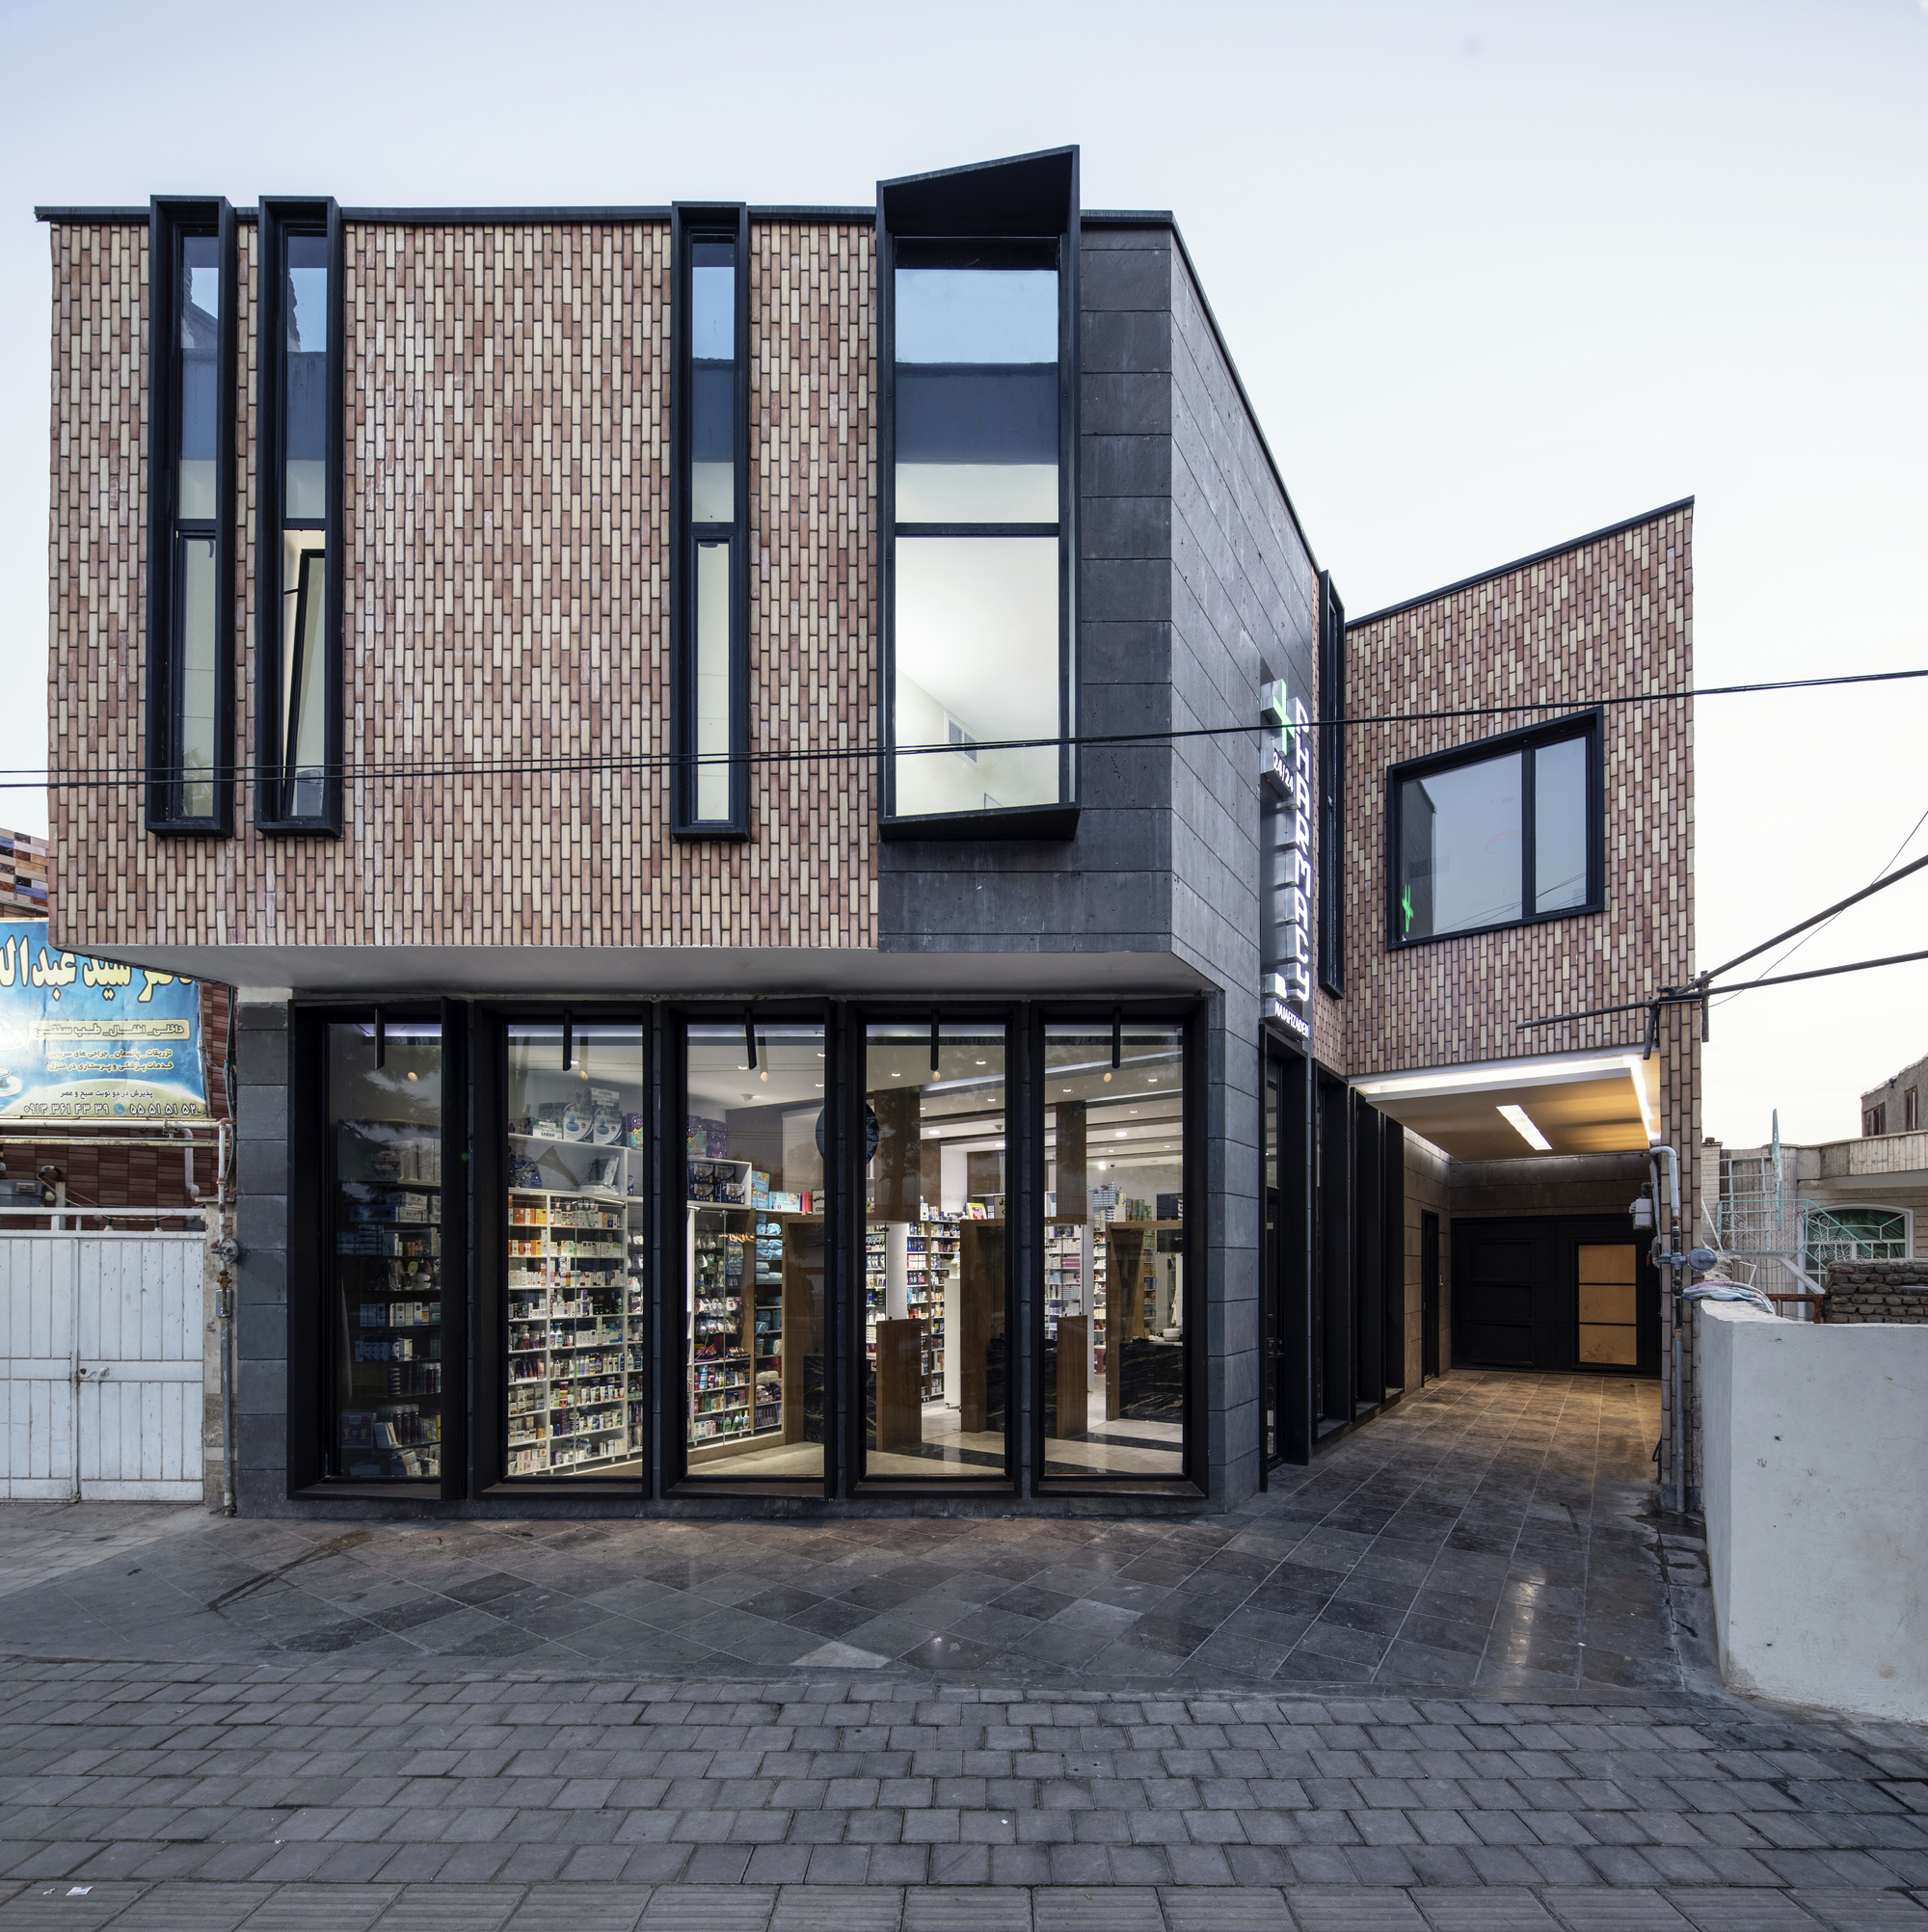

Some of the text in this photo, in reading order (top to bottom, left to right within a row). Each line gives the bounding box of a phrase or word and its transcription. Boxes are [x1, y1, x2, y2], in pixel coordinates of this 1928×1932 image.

[1296, 696, 1311, 1002] PHARMACY
[34, 1023, 72, 1038] سنتی
[73, 1023, 101, 1038] طب
[73, 1049, 87, 1060] های
[87, 1049, 109, 1060] جراحی
[67, 1062, 77, 1071] در
[118, 1060, 147, 1072] پزشکی
[146, 1060, 174, 1070] خدمات
[80, 1090, 94, 1099] صبح
[130, 1089, 154, 1099] پذیرش
[129, 1103, 146, 1115] ۵۵
[148, 1103, 162, 1115] ۵۱
[165, 1103, 178, 1115] ۵۱
